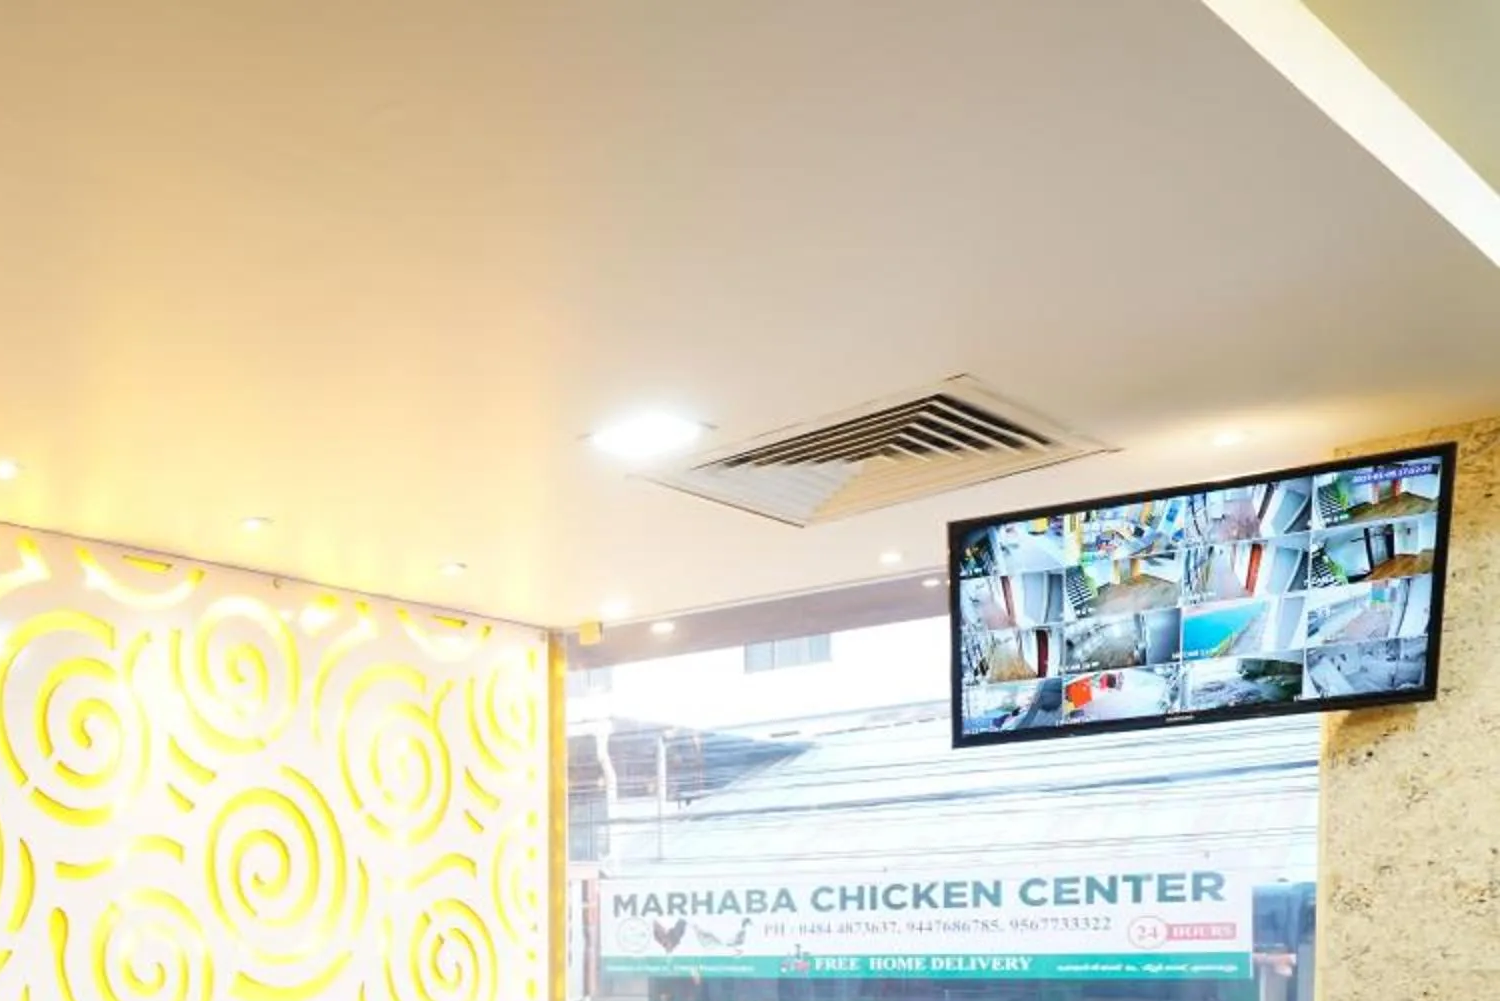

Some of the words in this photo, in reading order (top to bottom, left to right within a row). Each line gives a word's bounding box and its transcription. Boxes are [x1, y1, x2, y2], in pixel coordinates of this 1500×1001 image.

[612, 887, 798, 918] MARHABA
[809, 878, 1003, 912] CHICKEN
[1017, 870, 1226, 907] CENTER
[1136, 924, 1159, 941] 24
[814, 956, 861, 972] FREE
[868, 956, 928, 972] HOME
[930, 955, 1033, 972] DELIVERY
